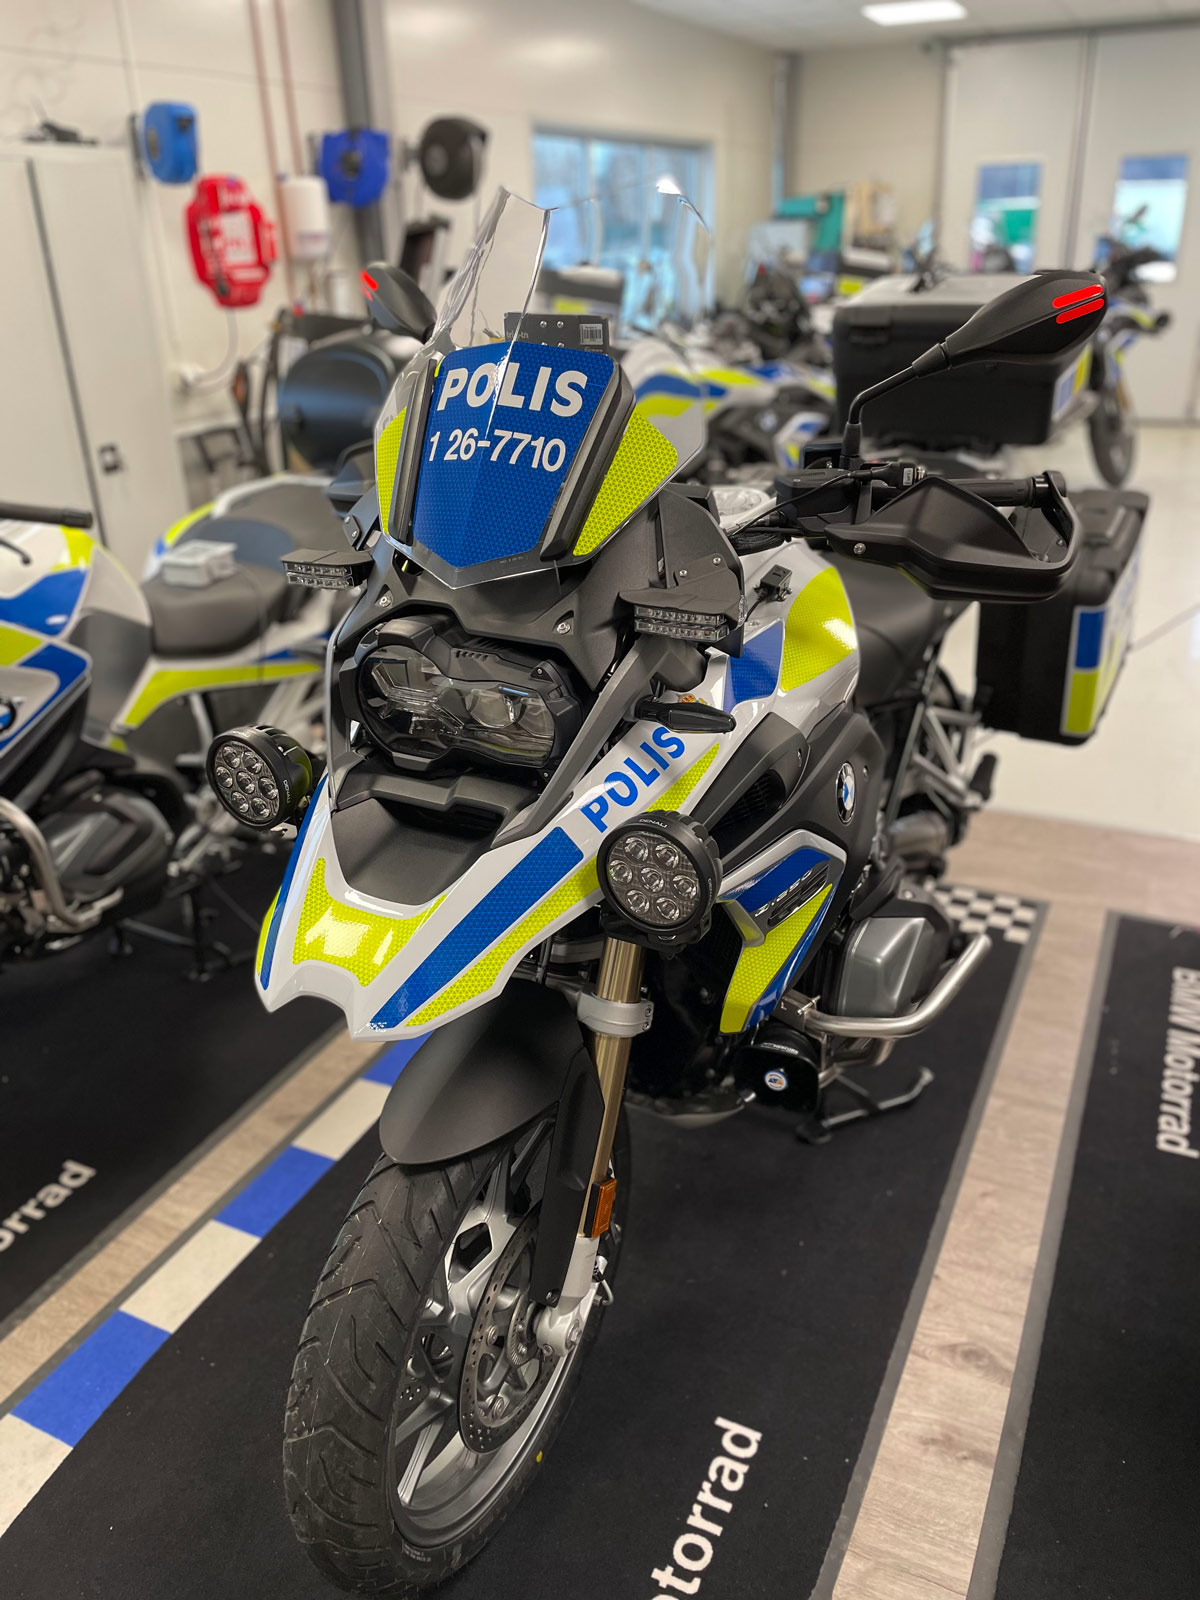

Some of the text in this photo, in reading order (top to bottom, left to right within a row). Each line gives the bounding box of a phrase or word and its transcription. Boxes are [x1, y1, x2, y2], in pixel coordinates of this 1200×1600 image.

[437, 361, 588, 417] POLIS
[443, 427, 566, 472] 26-7710
[580, 726, 685, 833] POLIS
[638, 818, 668, 829] DENALI
[1156, 965, 1200, 1160] BMW Motorrad
[650, 1416, 763, 1600] torrad
